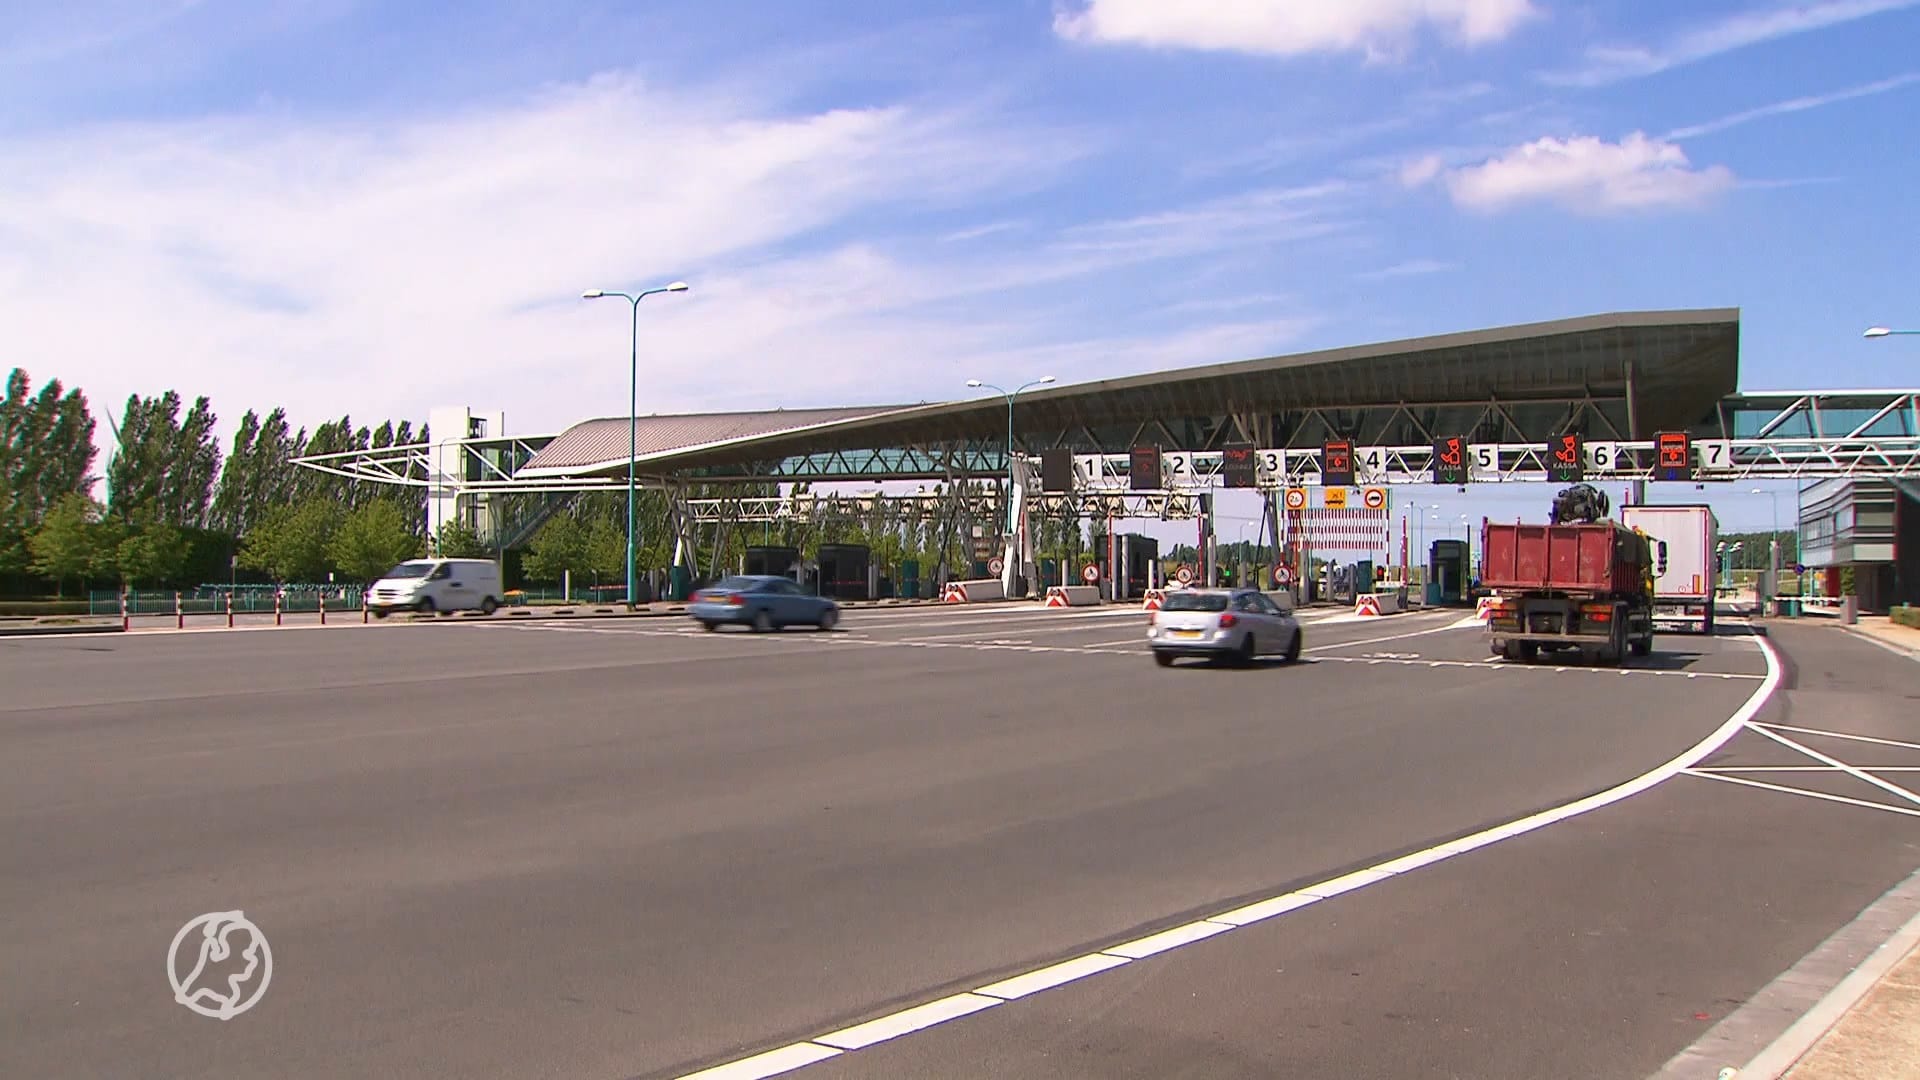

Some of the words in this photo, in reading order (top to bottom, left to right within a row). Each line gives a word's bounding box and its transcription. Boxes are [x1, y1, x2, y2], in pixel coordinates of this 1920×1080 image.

[1266, 453, 1278, 472] 3
[1366, 451, 1380, 469] 4
[1479, 448, 1491, 468] 5
[1594, 446, 1608, 466] 6
[1708, 444, 1722, 464] 7
[1085, 458, 1093, 476] 1
[1173, 456, 1185, 475] 2
[1438, 463, 1462, 471] KASSA
[1553, 462, 1577, 470] KASSA
